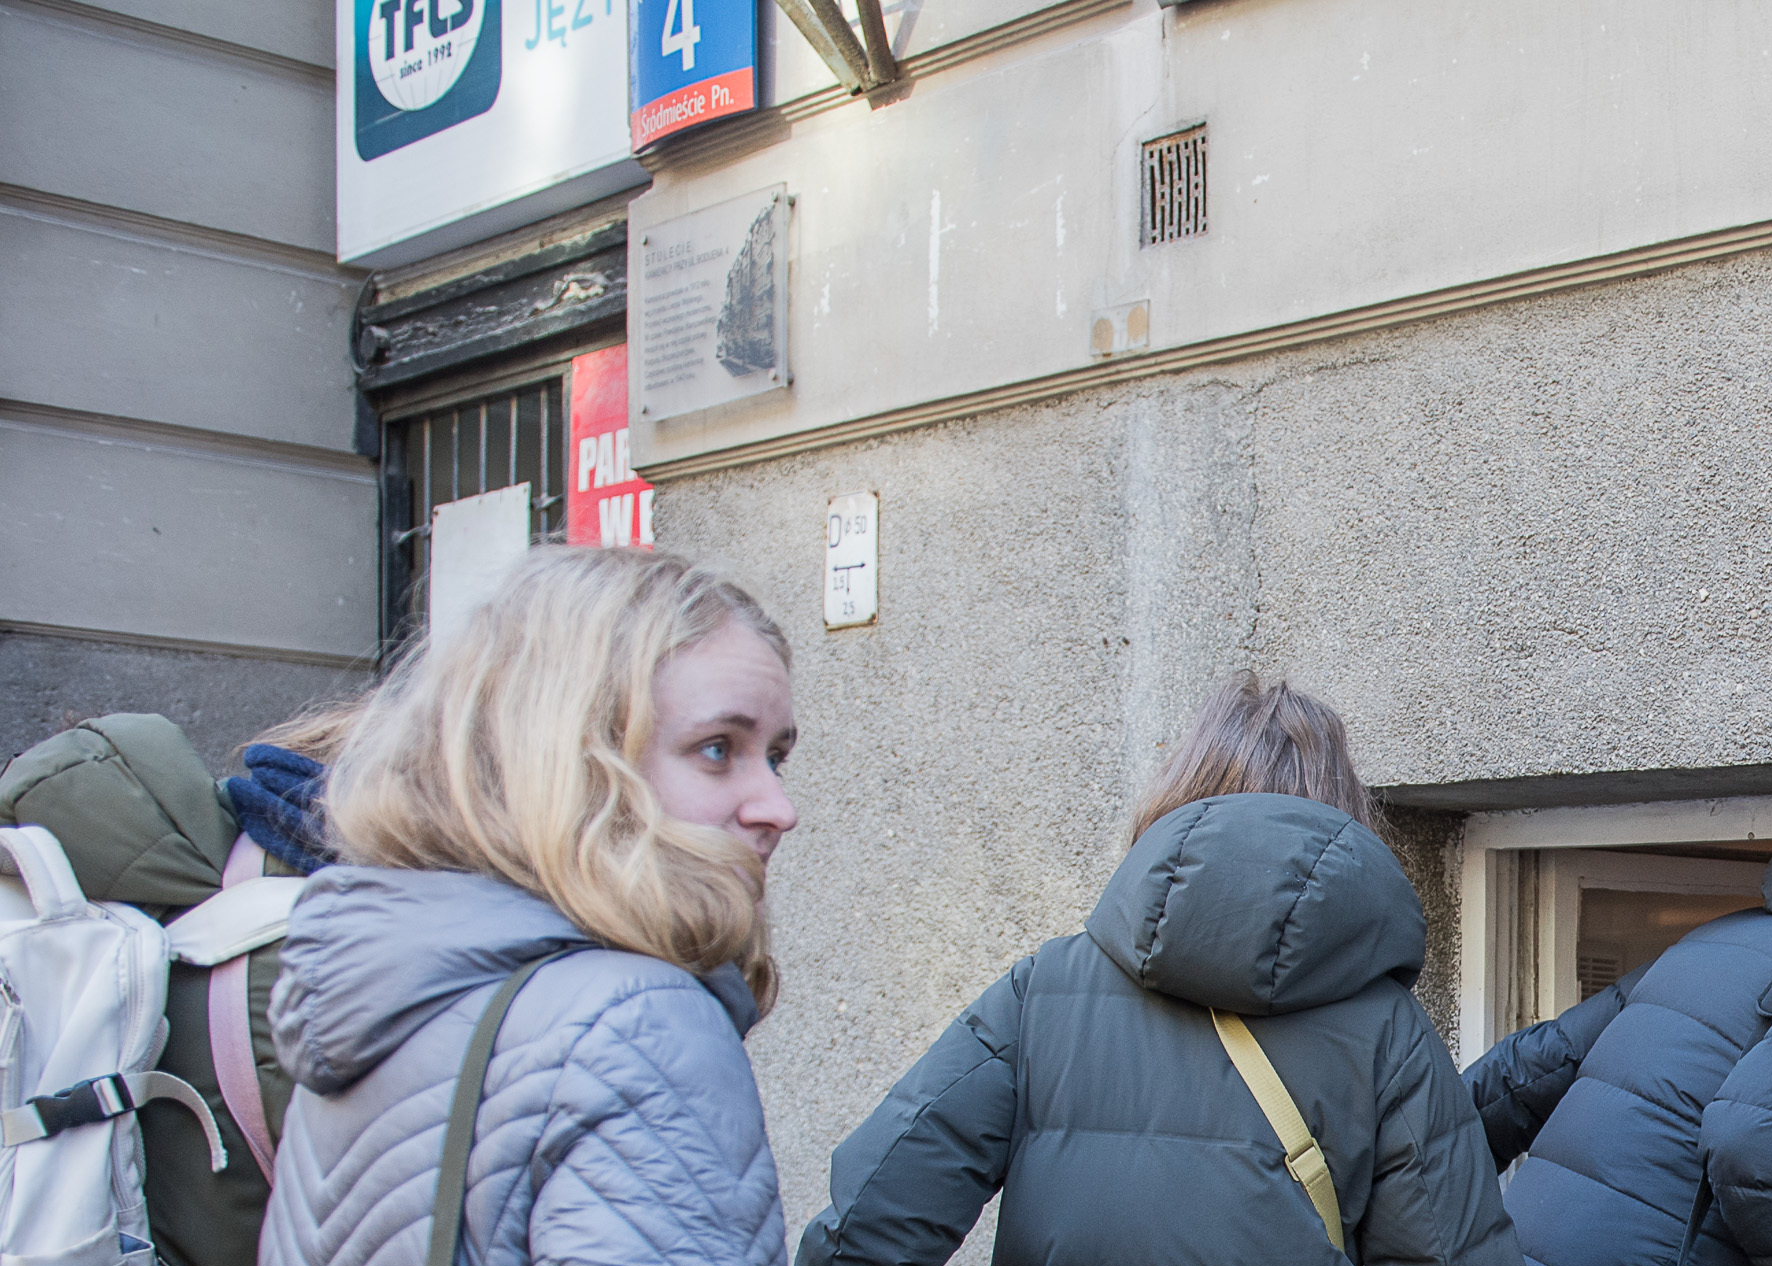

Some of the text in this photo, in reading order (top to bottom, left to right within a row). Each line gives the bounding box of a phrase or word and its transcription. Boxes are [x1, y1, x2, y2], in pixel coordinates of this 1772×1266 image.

[661, 0, 701, 72] 4
[400, 41, 452, 79] since 1992
[641, 84, 734, 138] Śródmieście Pn.
[828, 514, 842, 549] D
[855, 514, 867, 535] 50
